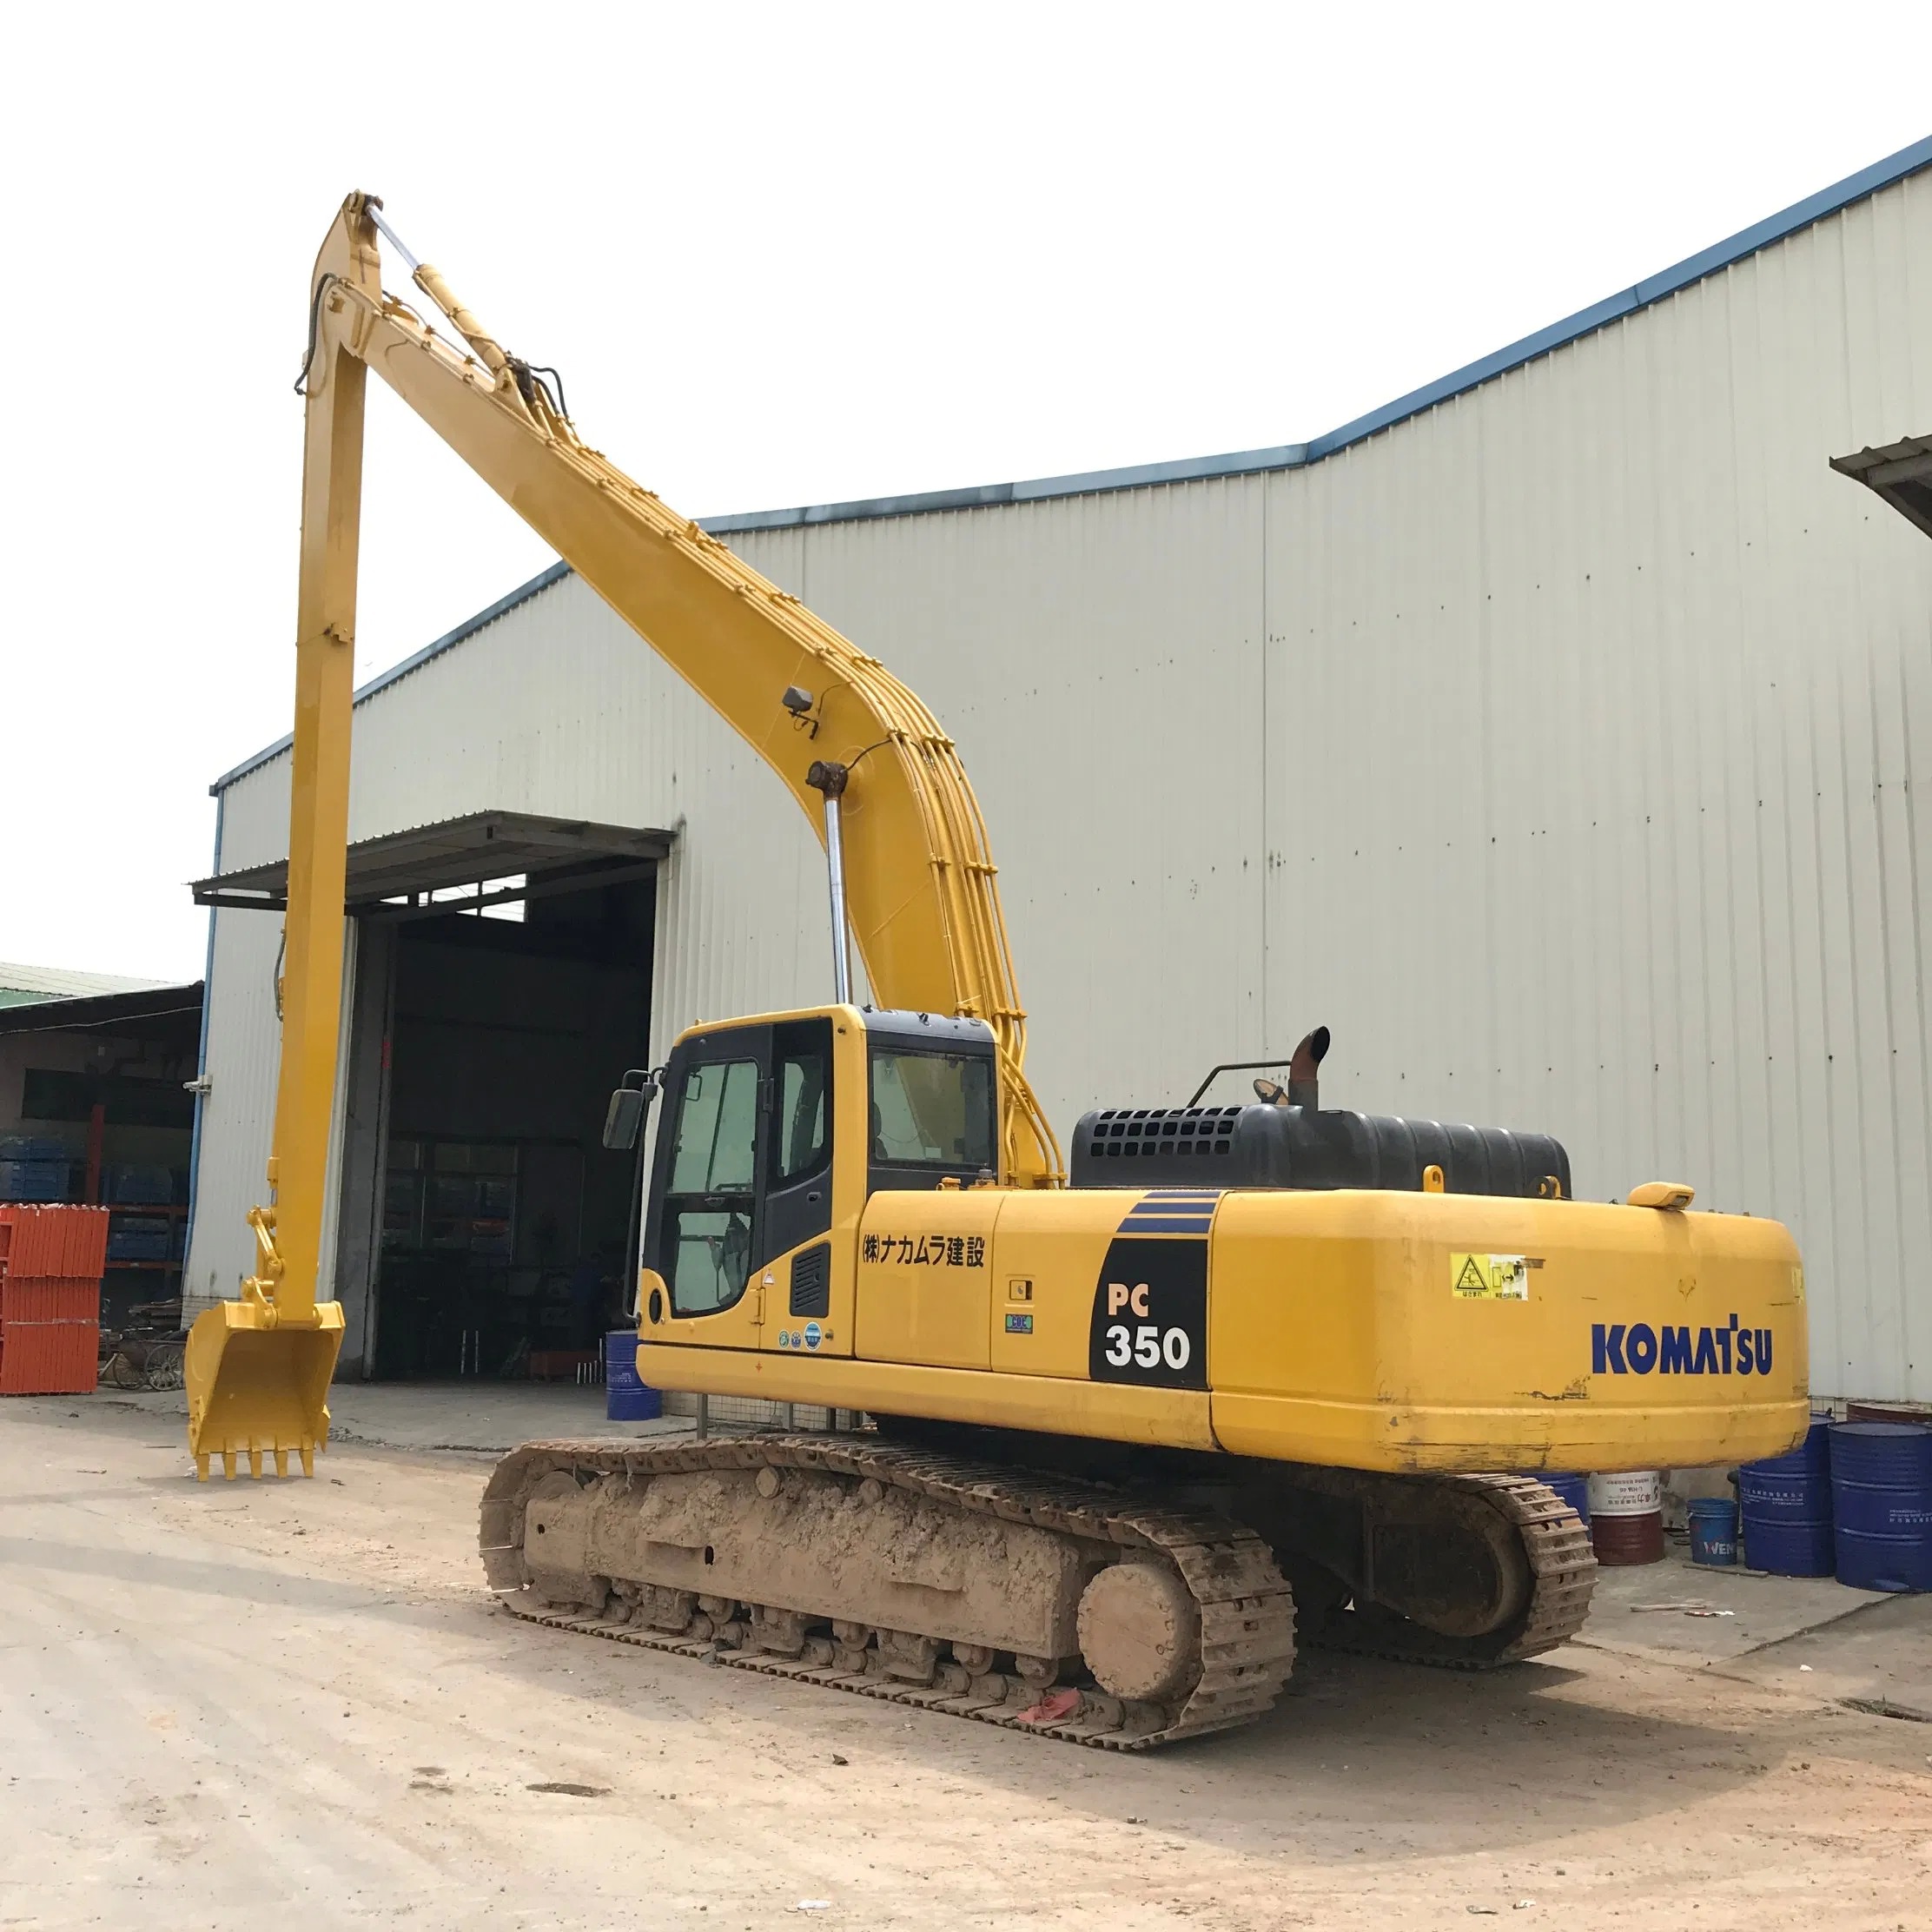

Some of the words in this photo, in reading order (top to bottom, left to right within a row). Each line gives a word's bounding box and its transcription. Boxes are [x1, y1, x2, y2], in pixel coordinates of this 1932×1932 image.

[863, 1234, 985, 1268] (株)ナカムラ建設
[1108, 1283, 1149, 1316] PC
[1105, 1326, 1190, 1370] 350
[1591, 1313, 1772, 1375] KOMATSU
